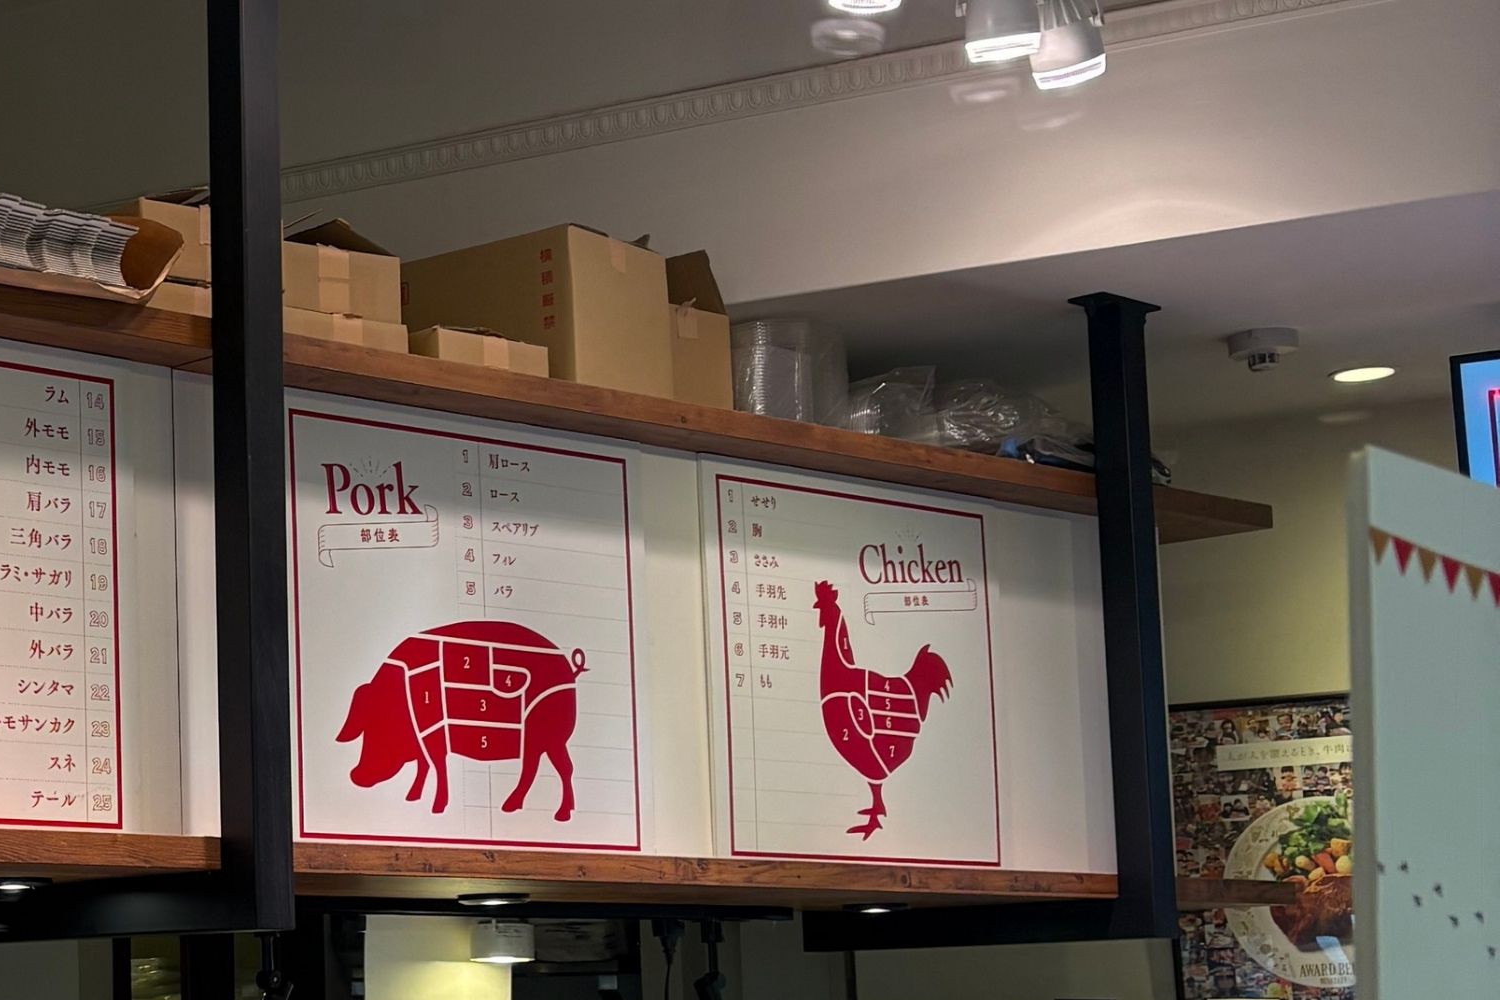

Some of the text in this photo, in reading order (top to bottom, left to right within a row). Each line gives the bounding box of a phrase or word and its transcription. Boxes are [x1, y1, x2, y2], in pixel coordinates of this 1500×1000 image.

[45, 386, 70, 404] ラム
[24, 418, 70, 441] 外モモ
[25, 454, 107, 483] 内モモ 16
[462, 450, 531, 473] 1 肩ロース
[320, 461, 423, 516] Pork
[462, 482, 520, 503] 2 ロース
[26, 491, 107, 519] 肩バラ 17
[727, 488, 777, 510] 1 せせり
[463, 515, 540, 537] 3 スペアリブ
[728, 520, 738, 534] 2
[9, 527, 73, 551] 三角バラ
[360, 528, 400, 543] 部位表
[464, 548, 517, 567] 4 フィレ
[729, 550, 780, 569] 3 ささみ
[858, 543, 965, 585] Chicken
[90, 573, 108, 591] 19
[466, 581, 514, 598] 5 バラ
[731, 581, 787, 601] 4 手羽先
[903, 594, 930, 608] 部位表
[29, 602, 109, 628] 中バラ 20
[733, 611, 788, 630] 5 手羽中
[29, 639, 108, 665] 外バラ 21
[734, 642, 790, 660] 6 手羽元
[463, 656, 471, 670] 2
[504, 674, 512, 687] 4
[735, 673, 745, 688] 7
[884, 680, 890, 692] 4
[17, 679, 110, 702] シンタマ 22
[424, 691, 430, 704] 1
[480, 699, 487, 712] 3
[885, 699, 891, 711] 5
[858, 708, 864, 721] 3
[886, 717, 892, 729] 6
[91, 720, 111, 738] 23
[842, 728, 849, 741] 2
[481, 736, 488, 748] 5
[889, 745, 896, 758] 7
[48, 753, 112, 775] スネ 24
[31, 790, 113, 812] テール 25
[1300, 962, 1337, 979] AWARD
